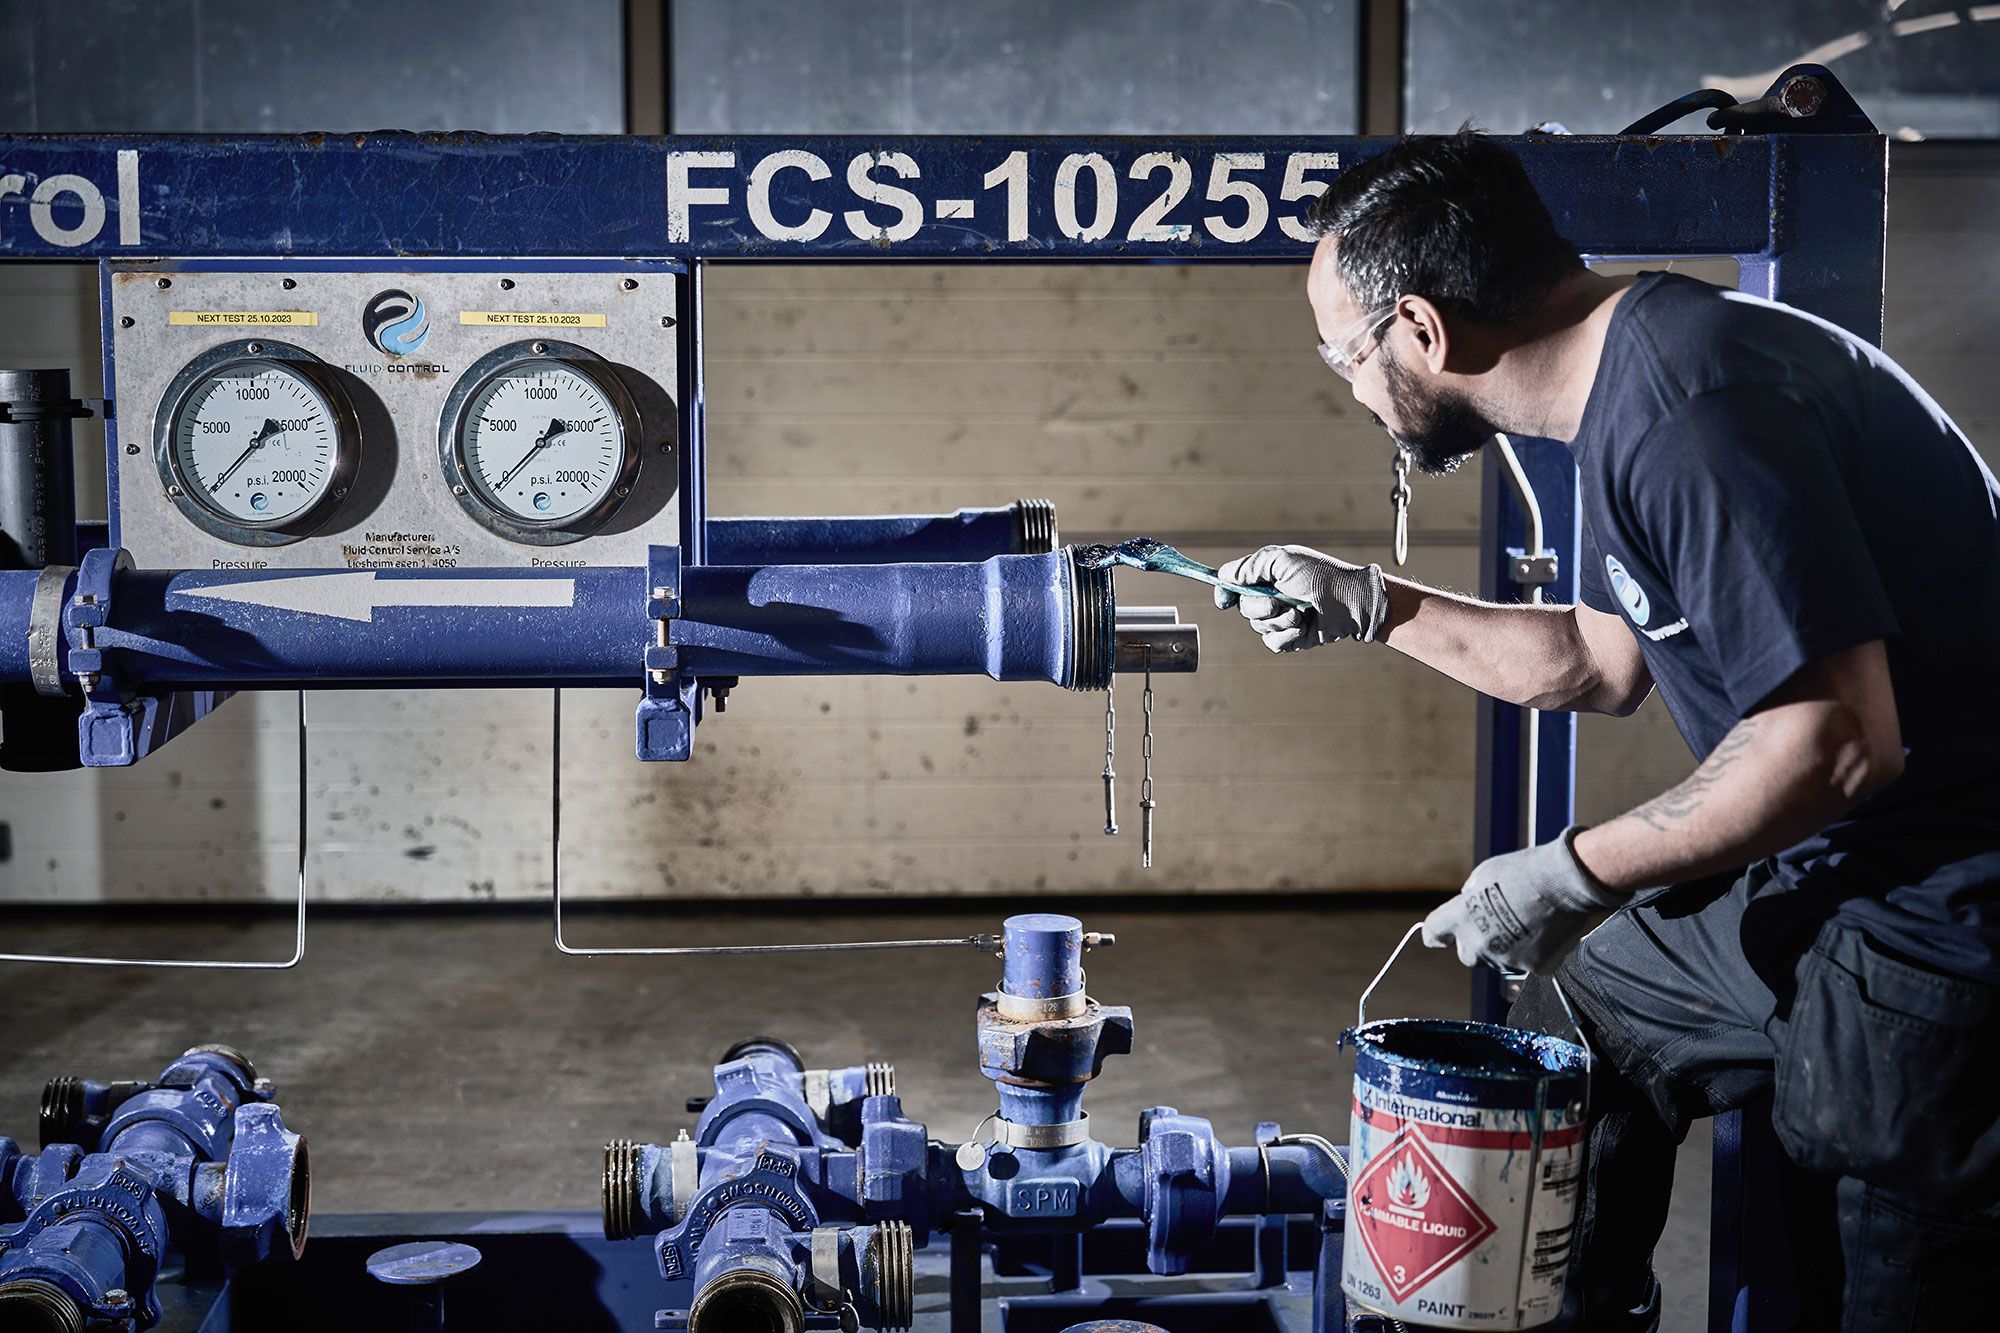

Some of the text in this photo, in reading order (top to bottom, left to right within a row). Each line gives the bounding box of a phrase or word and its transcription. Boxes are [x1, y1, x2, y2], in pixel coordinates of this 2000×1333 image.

[666, 149, 1341, 243] FCS-10255
[197, 313, 292, 323] NEXT TEST 25.10.2023
[486, 314, 581, 324] NEXT TEST 25.10.2023
[345, 364, 450, 373] FLUID CONTROL
[236, 388, 270, 400] 10000
[524, 388, 558, 400] 10000
[202, 422, 230, 434] 5000
[489, 420, 517, 432] 5000
[563, 420, 594, 432] 5000
[247, 470, 306, 488] p.s.i. 20000
[530, 470, 590, 486] p.s.i. 20000
[406, 546, 441, 555] Service
[444, 545, 461, 555] A/S
[212, 559, 268, 570] Pressure
[433, 558, 457, 568] 4050
[532, 558, 587, 569] Pressure
[1017, 1187, 1071, 1211] SPM
[1423, 1219, 1467, 1239] LIQUID
[1393, 1265, 1406, 1284] 3
[1358, 1280, 1381, 1300] 1263
[1418, 1299, 1466, 1319] PAINT
